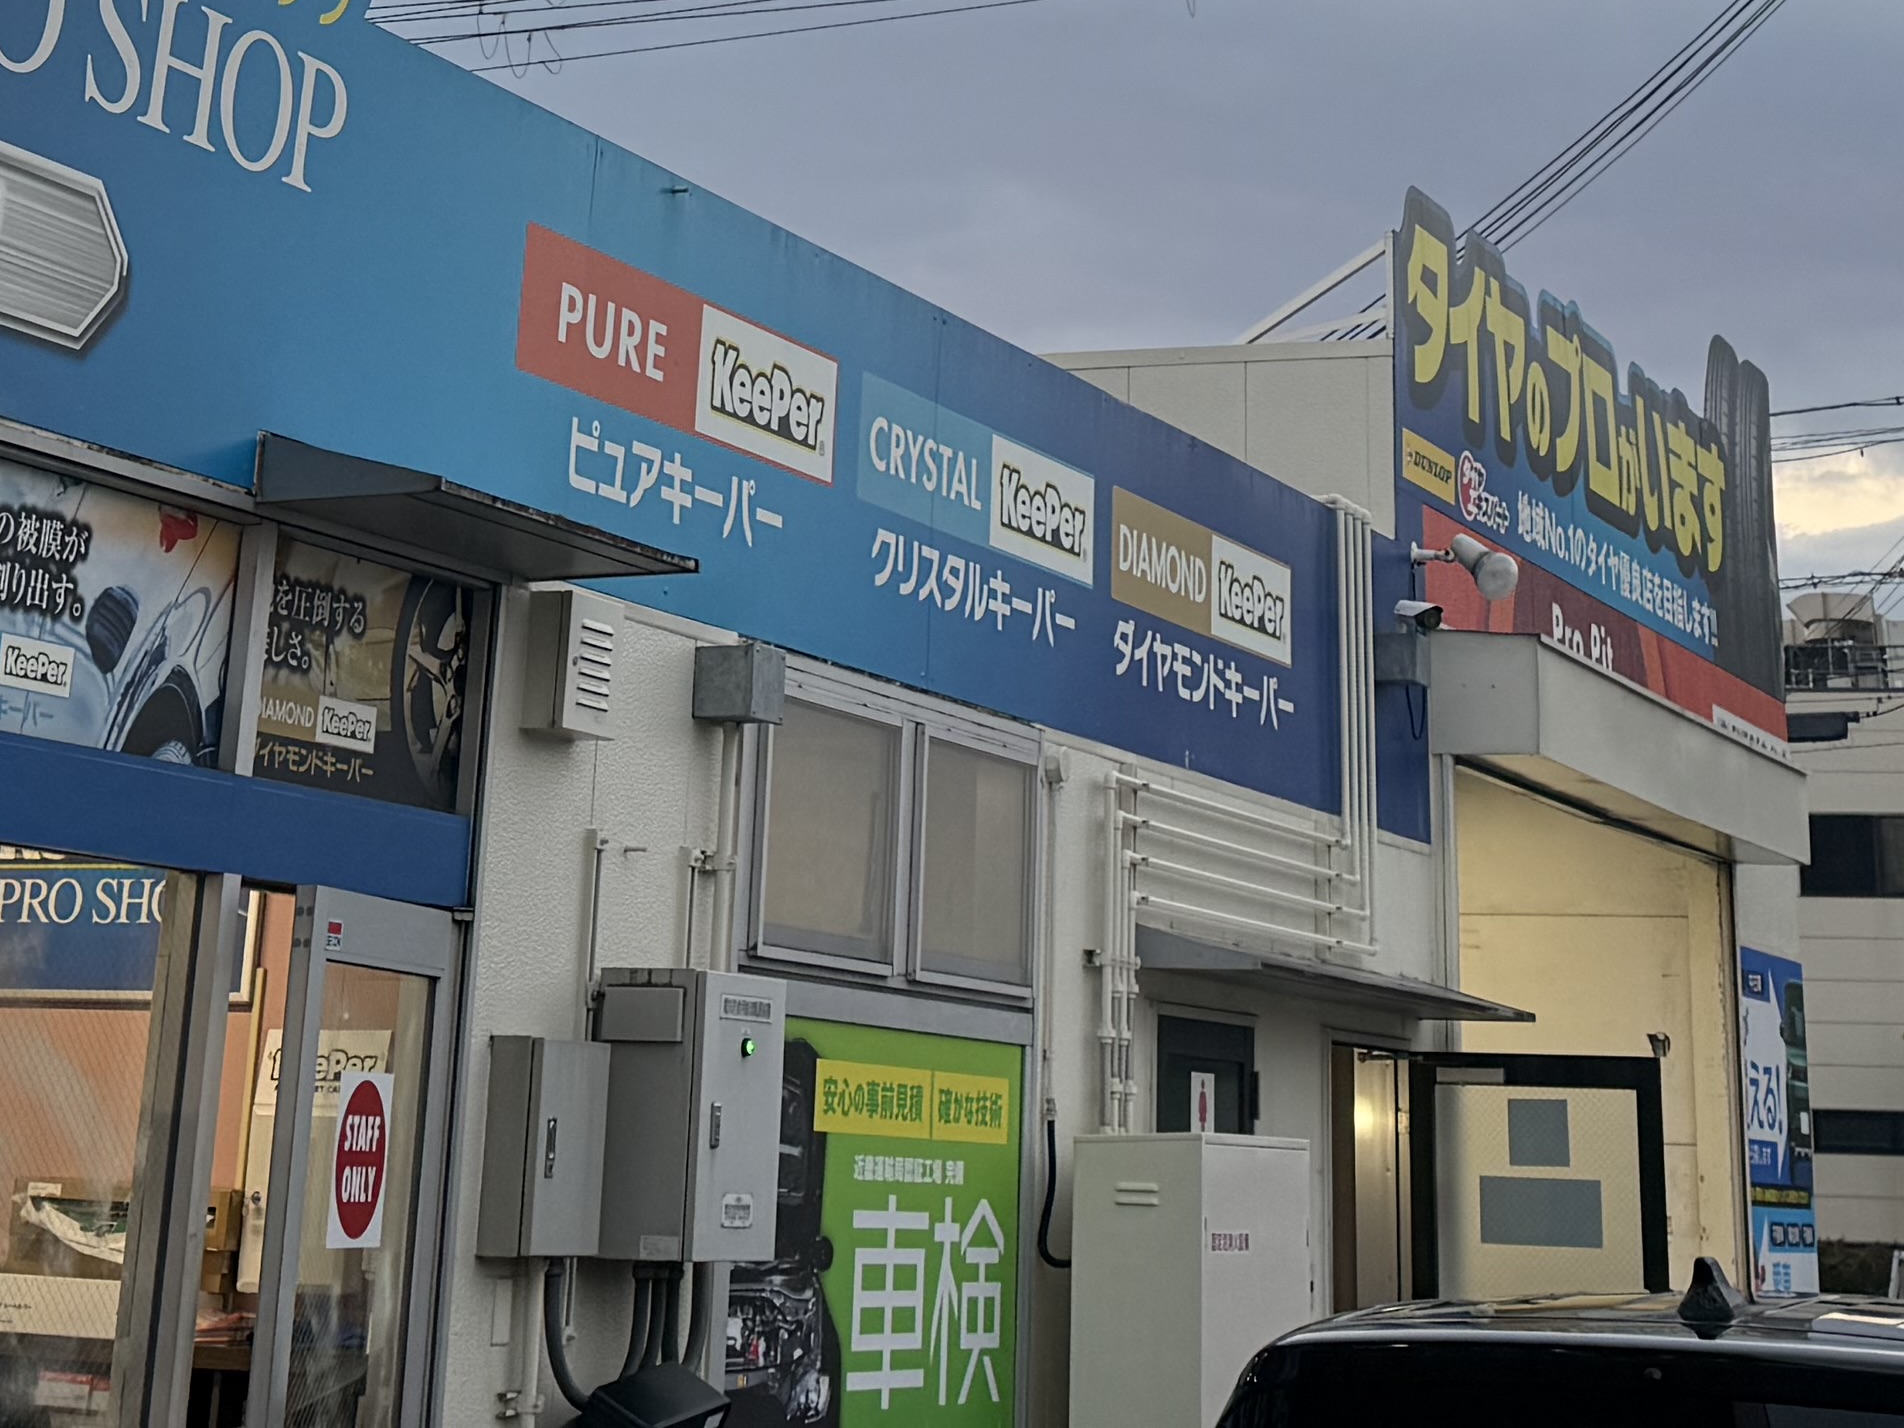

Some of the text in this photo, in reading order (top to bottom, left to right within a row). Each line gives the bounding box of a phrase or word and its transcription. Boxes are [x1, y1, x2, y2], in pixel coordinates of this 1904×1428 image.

[557, 281, 825, 451] PURE KeePer
[1407, 223, 1726, 573] タイヤのプロがいます
[568, 416, 783, 547] ピュアキーパー
[869, 416, 1086, 558] CRYSTAL KeePer
[1413, 450, 1452, 485] DUNLOP
[269, 579, 365, 633] を圧倒する
[870, 527, 1076, 648] クリスタルキーパー
[1118, 523, 1285, 642] DIAMOND KeePer
[263, 626, 310, 669] しさ。
[1551, 601, 1614, 672] Pro Pit
[4, 645, 68, 685] KeePer
[1113, 619, 1295, 731] ダイヤモンドキーパー
[261, 696, 371, 742] IAMOND KeePer
[255, 737, 374, 783] イヤモンドキーパー
[271, 1048, 378, 1082] ePer
[822, 1075, 1003, 1129] 安心の事前見積 確かな技術
[344, 1114, 381, 1152] STAFF
[341, 1165, 377, 1203] ONLY
[845, 1194, 1005, 1412] 車検
